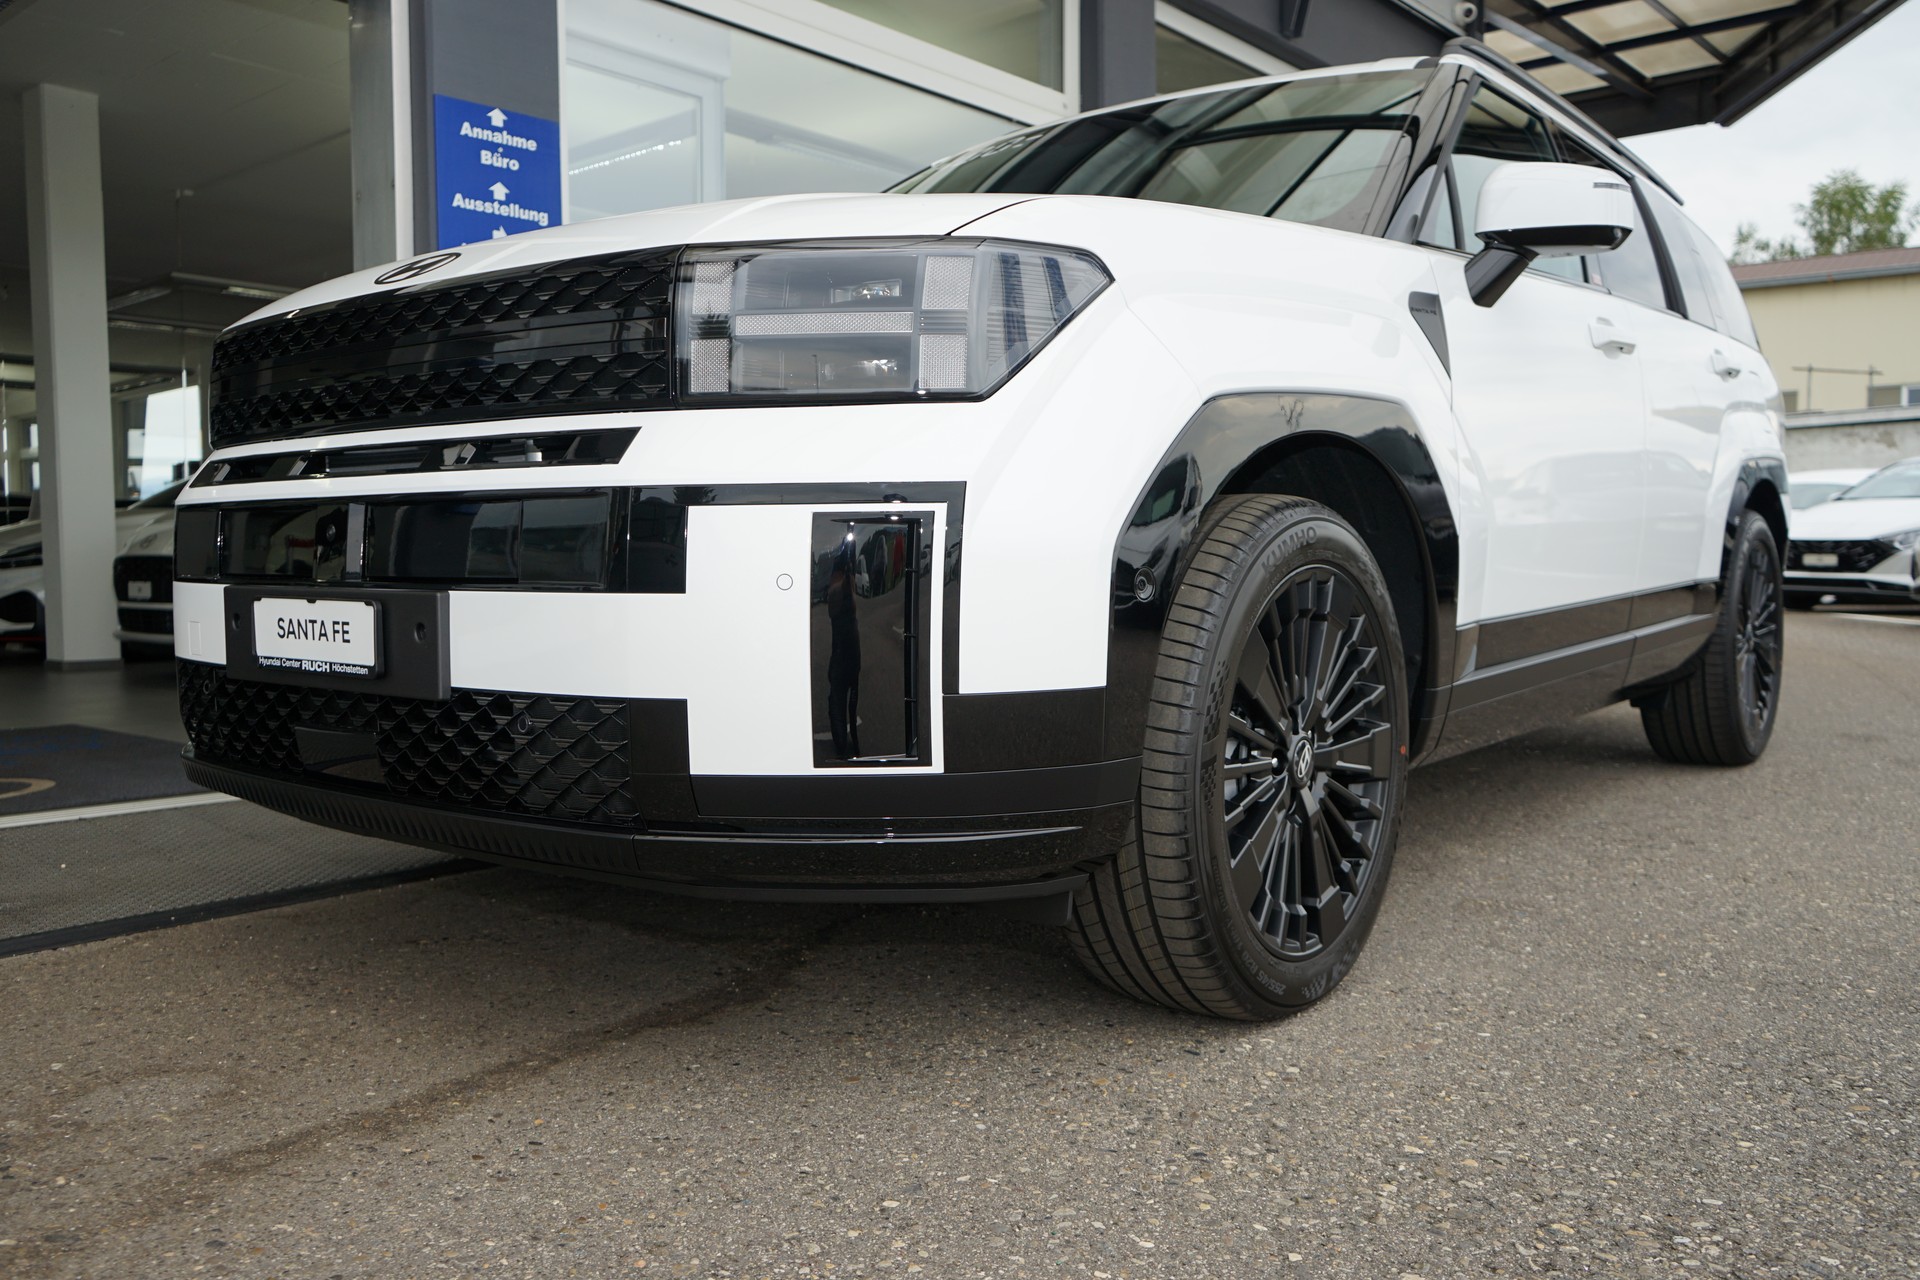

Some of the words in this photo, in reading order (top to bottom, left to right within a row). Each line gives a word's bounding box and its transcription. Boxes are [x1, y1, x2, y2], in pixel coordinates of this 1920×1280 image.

[460, 121, 538, 151] Annahme
[480, 149, 520, 171] Büro
[452, 193, 549, 226] Ausstellung
[1261, 526, 1317, 573] KUMHO
[277, 617, 329, 642] SANTA
[332, 620, 351, 643] FE
[259, 656, 281, 667] Hyundai
[281, 658, 301, 669] Center
[301, 660, 330, 673] RUCH
[331, 663, 368, 675] Höchstetten
[1241, 950, 1259, 975] R20
[1256, 970, 1287, 996] 255/45
